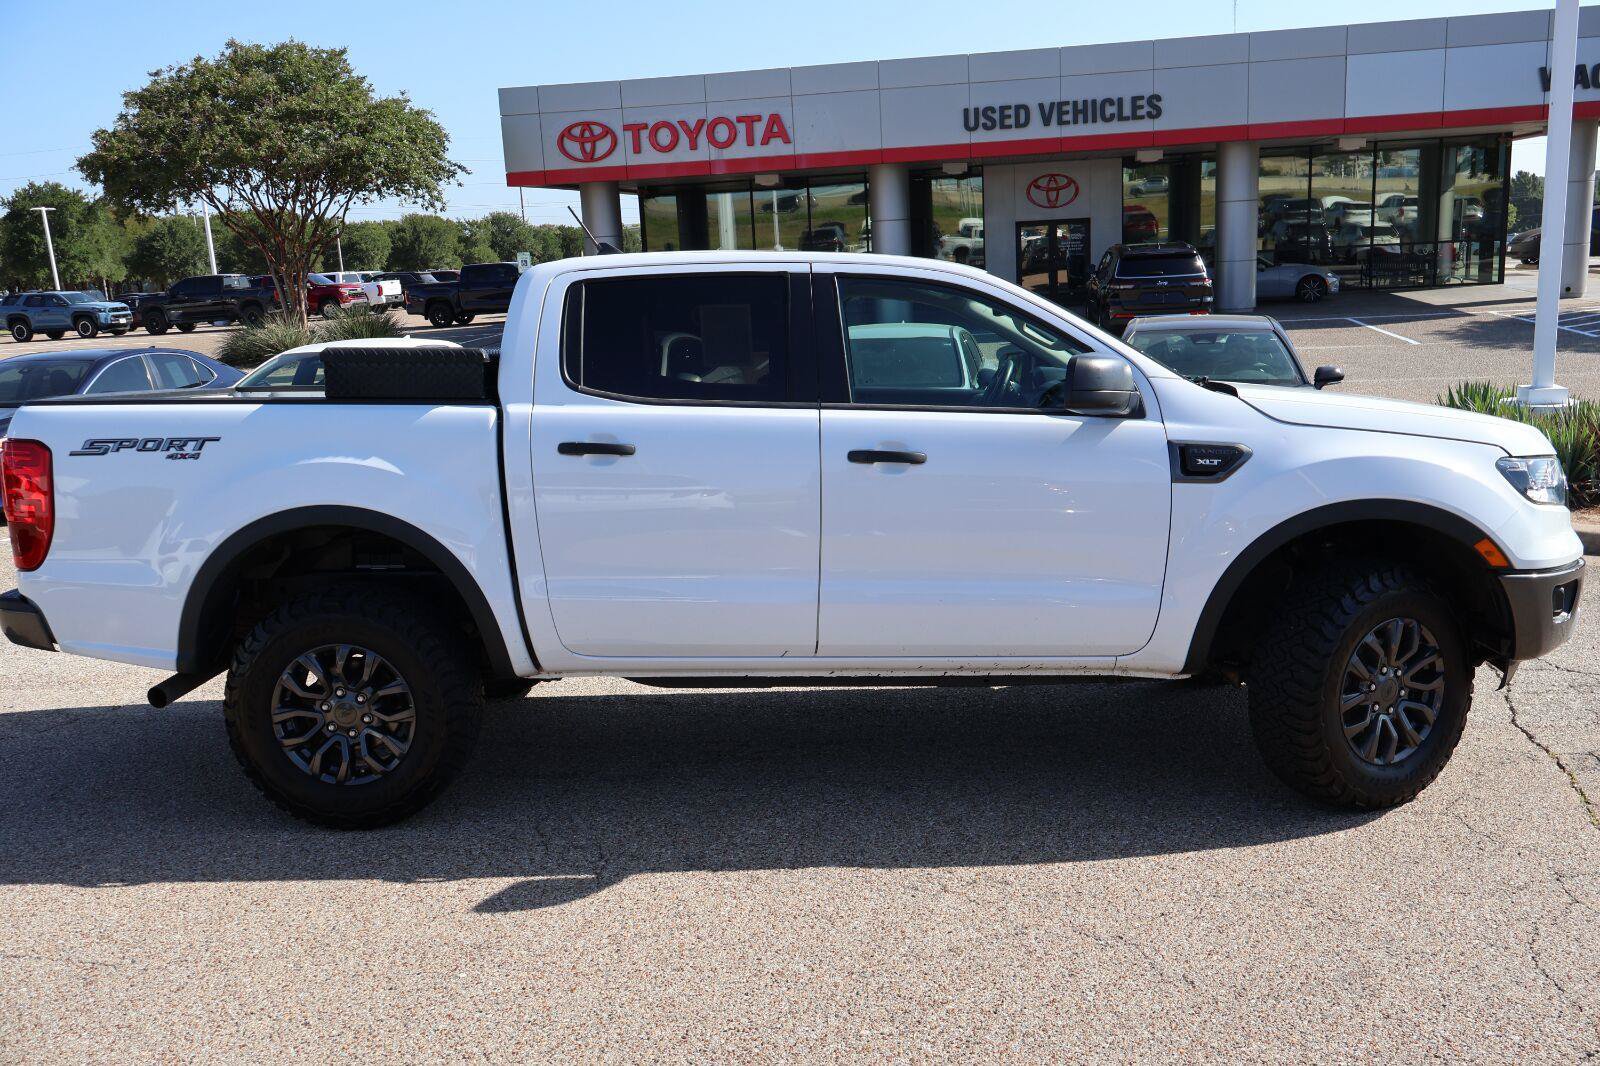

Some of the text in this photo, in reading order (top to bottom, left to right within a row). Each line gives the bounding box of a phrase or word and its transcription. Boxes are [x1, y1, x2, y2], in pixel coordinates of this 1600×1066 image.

[963, 93, 1163, 132] USED VEHICLES
[623, 113, 792, 154] TOYOTA
[69, 437, 221, 456] SPORT
[1196, 458, 1222, 466] XLT
